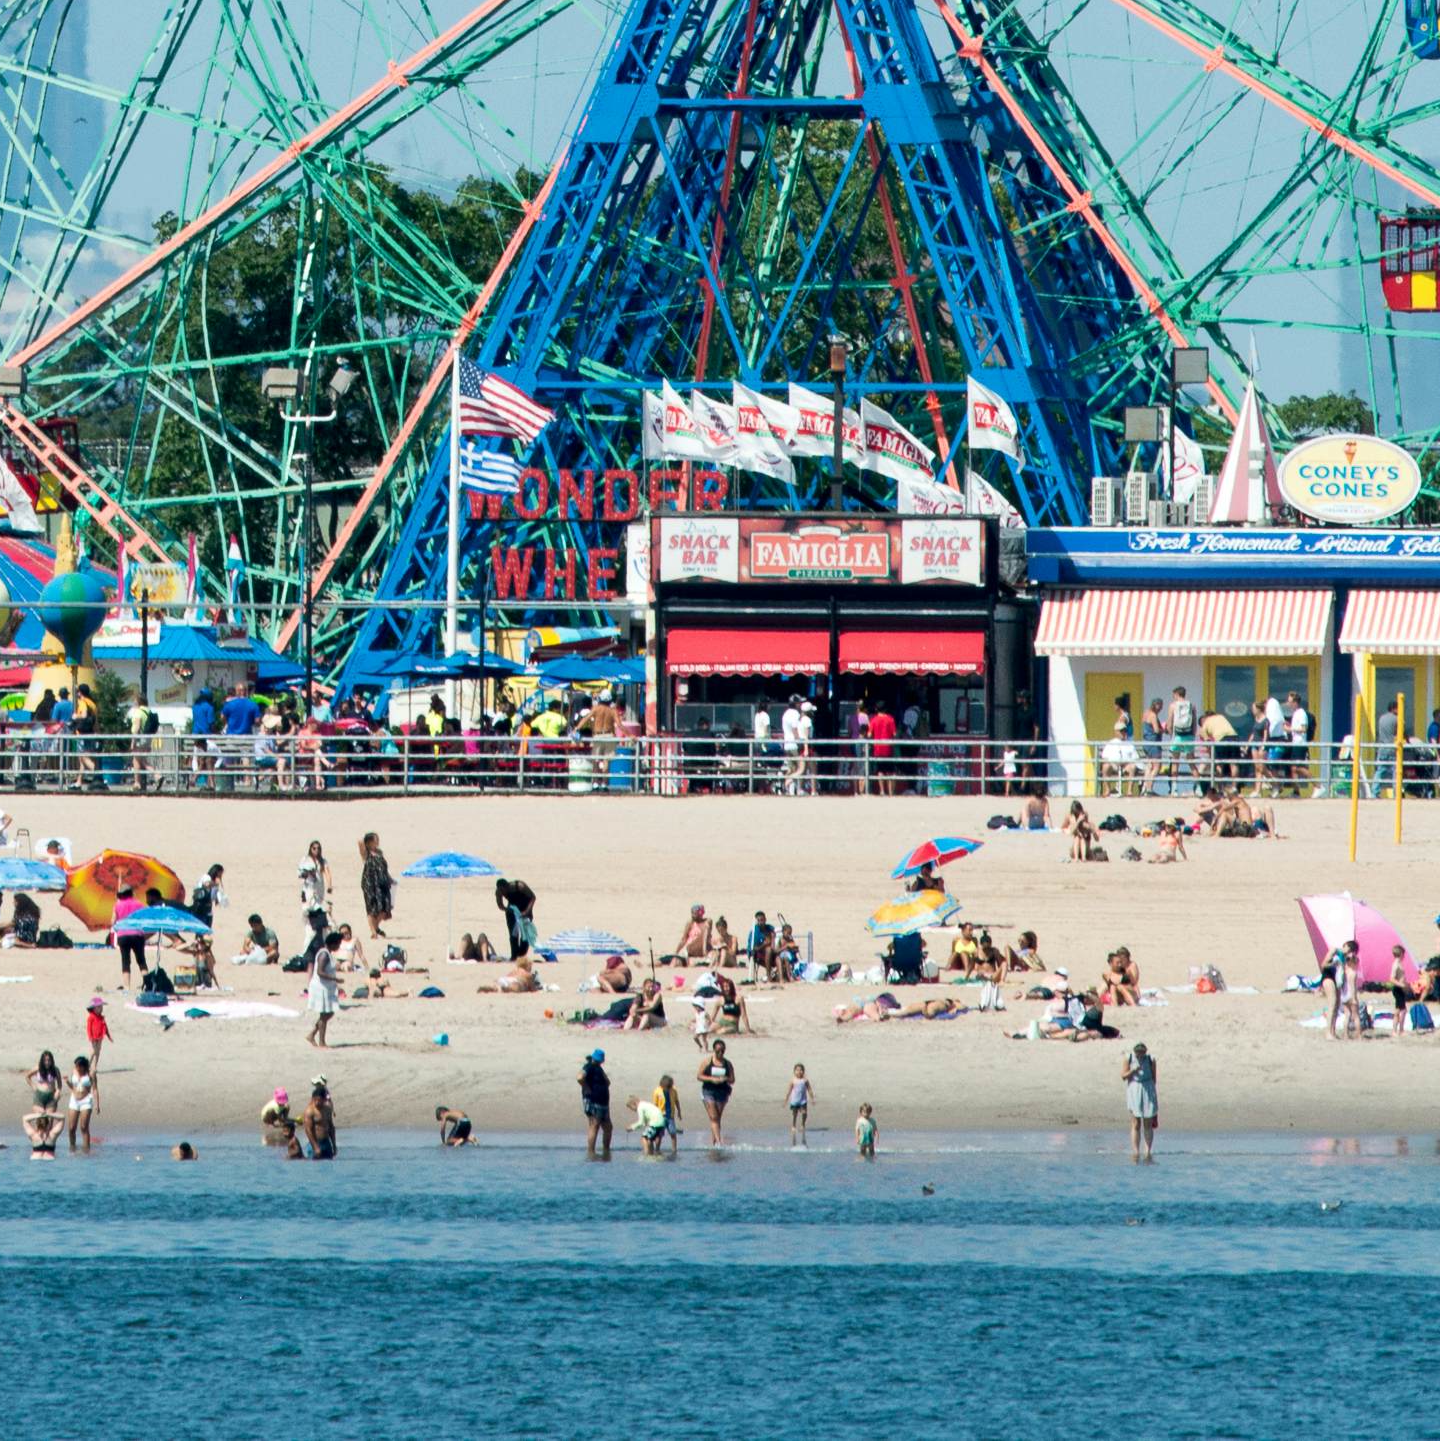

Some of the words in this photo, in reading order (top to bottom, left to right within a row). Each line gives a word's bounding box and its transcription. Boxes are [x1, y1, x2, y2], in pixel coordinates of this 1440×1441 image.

[1298, 464, 1399, 481] CONEY'S
[1309, 482, 1389, 498] CONES
[668, 534, 731, 550] SNACK
[910, 536, 973, 551] SNACK
[1131, 532, 1191, 551] Fresh
[1191, 533, 1302, 555] Homemade
[682, 551, 718, 565] BAR
[756, 542, 882, 567] FAMIGLIA
[923, 552, 960, 566] BAR
[491, 547, 619, 600] WHE
[795, 568, 845, 578] PIZZERIA
